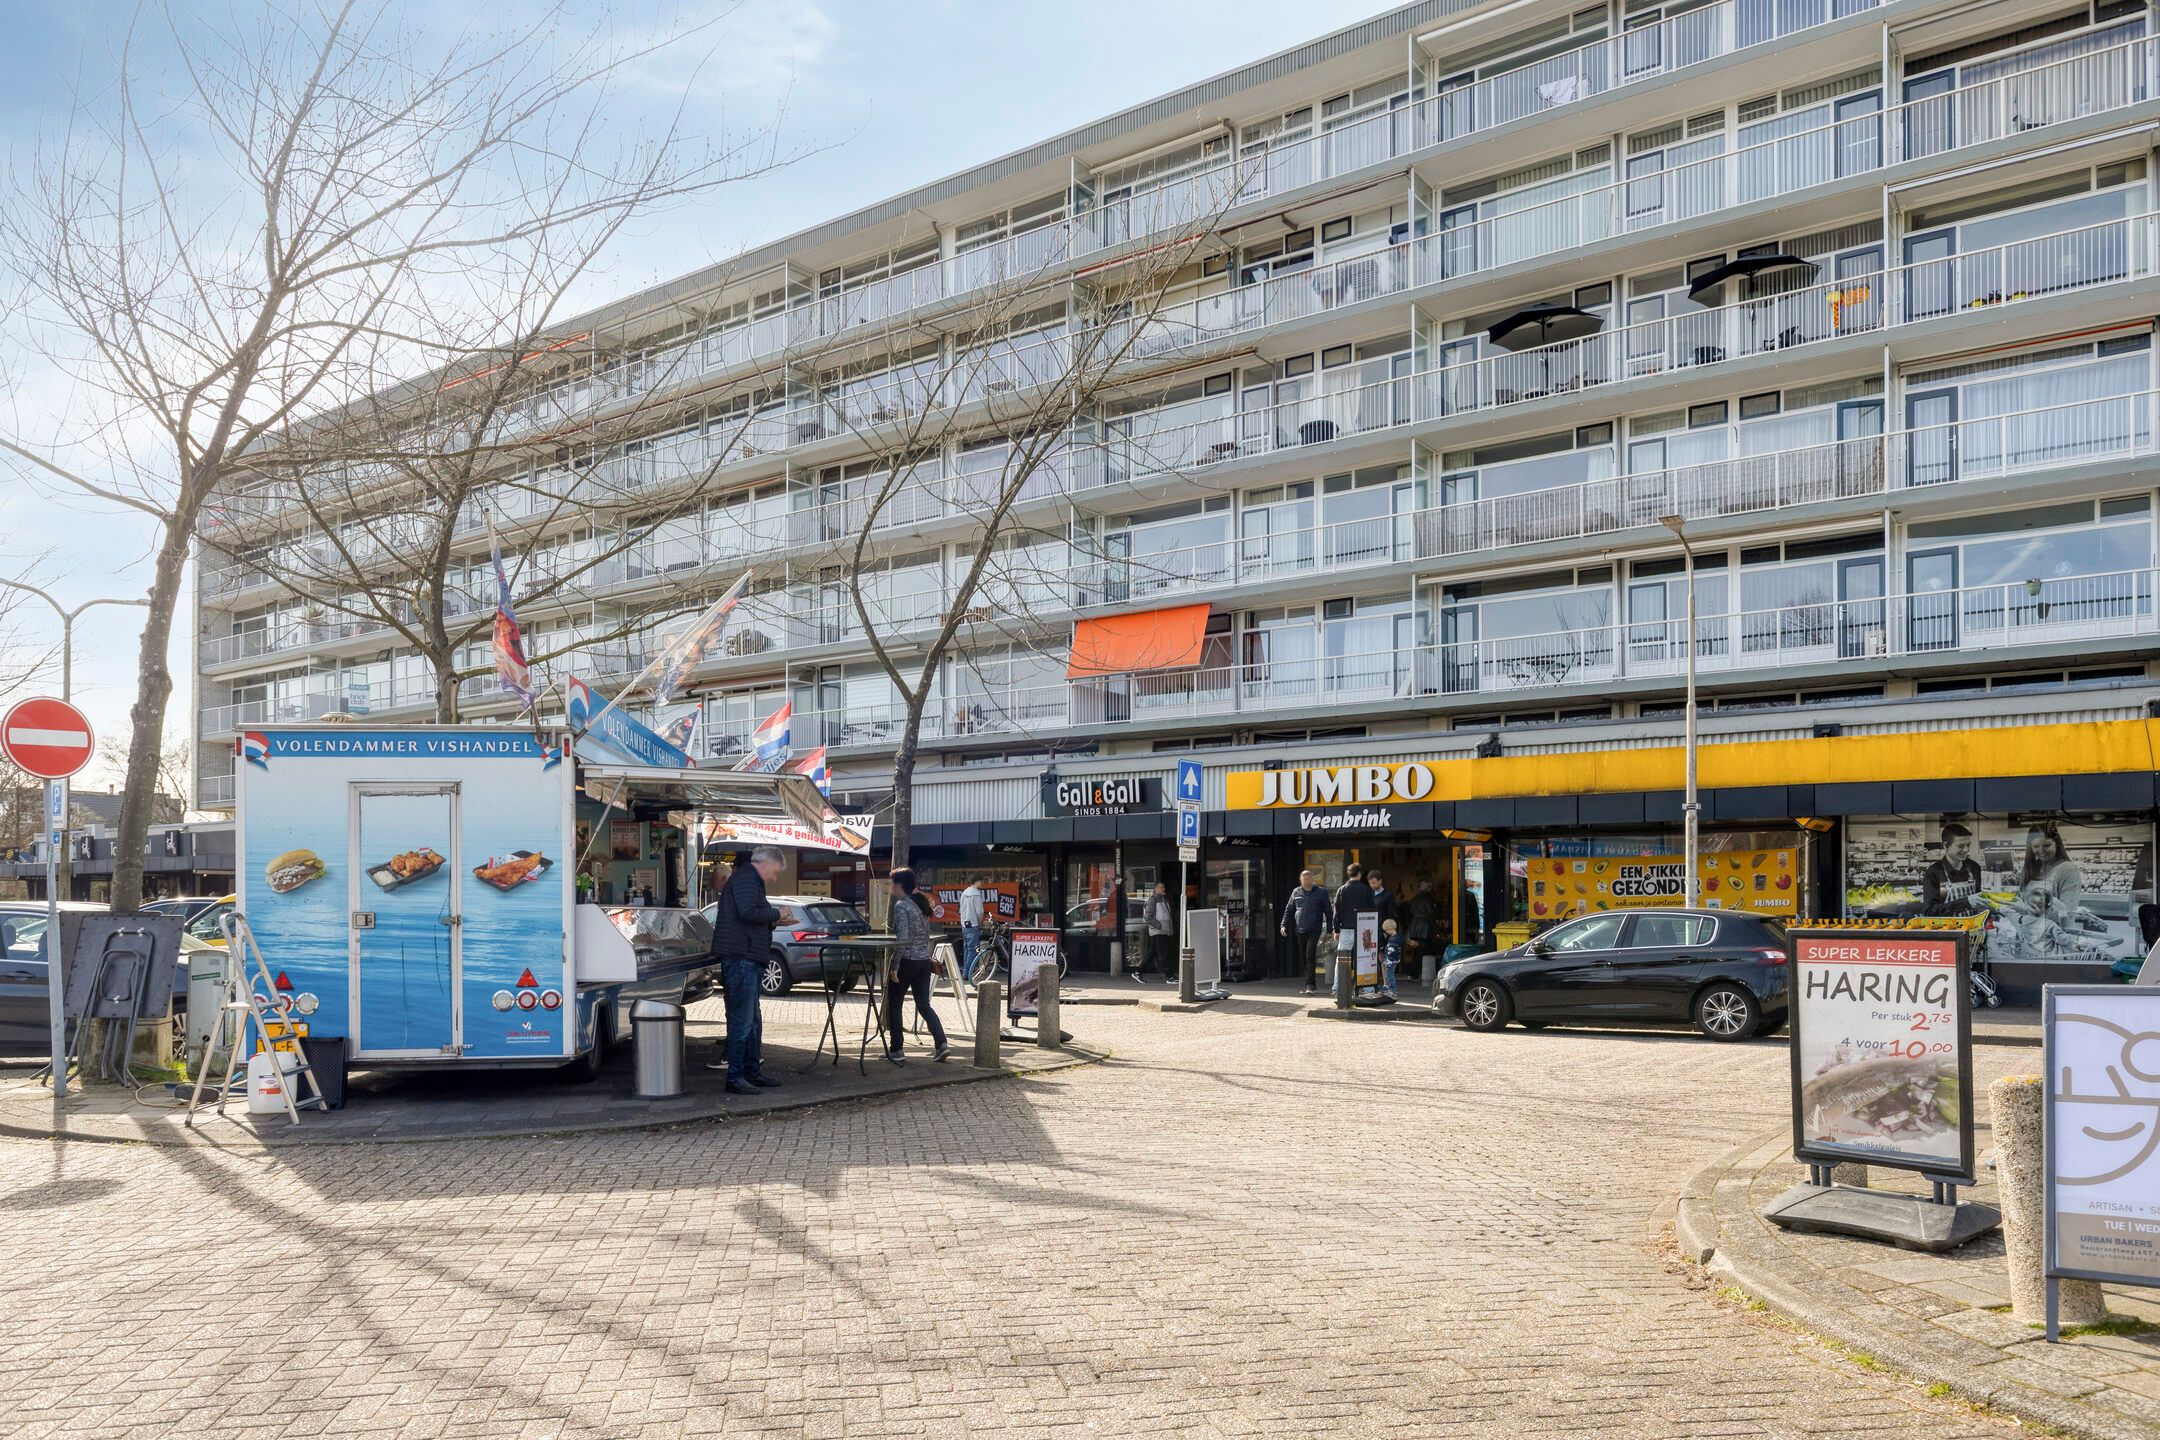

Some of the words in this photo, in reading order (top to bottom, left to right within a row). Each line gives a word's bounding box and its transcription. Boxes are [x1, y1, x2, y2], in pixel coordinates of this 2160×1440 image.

[602, 713, 652, 759] VOLENDAMMER
[276, 740, 418, 752] VOLENDAMMER
[427, 740, 532, 753] VISHANDEL
[1256, 763, 1434, 806] JUMBO
[1074, 808, 1101, 816] SINDS
[1104, 806, 1125, 815] 1884
[1185, 814, 1194, 835] P
[1300, 808, 1392, 830] Veenbrink
[1620, 865, 1643, 879] EEN
[1753, 899, 1790, 907] JUMBO
[1014, 944, 1055, 959] HARING
[1808, 947, 1860, 960] SUPER
[1866, 948, 1942, 962] LEKKERE
[1806, 969, 1949, 1009] HARING
[1871, 1011, 1889, 1021] Per
[1891, 1011, 1912, 1021] stuk
[1910, 1012, 1953, 1032] 2,75
[1841, 1037, 1850, 1048] 4
[1856, 1039, 1887, 1050] voor
[1887, 1039, 1953, 1060] 10,00
[2089, 1201, 2133, 1212] ARTISAN
[2104, 1220, 2126, 1231] TUE
[2134, 1223, 2160, 1233] WED
[2080, 1235, 2112, 1244] URBAN
[2115, 1238, 2153, 1248] BAKERS
